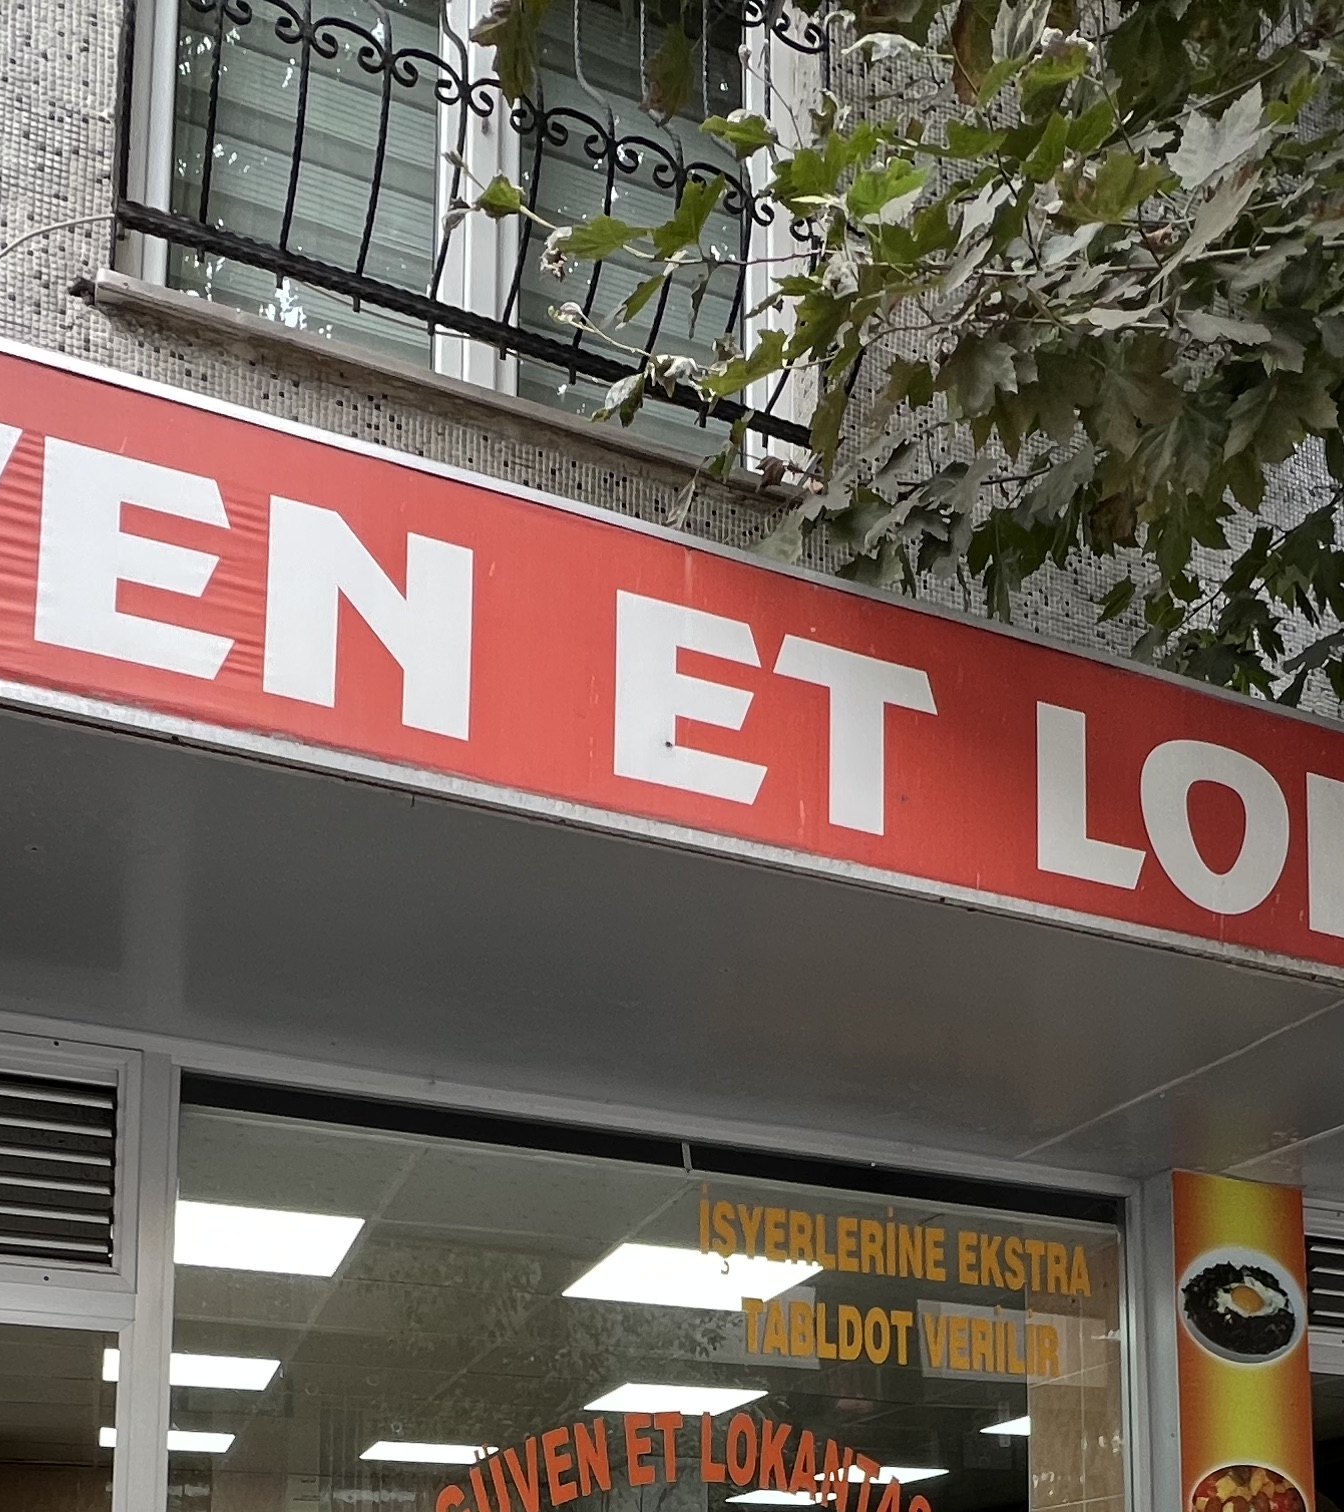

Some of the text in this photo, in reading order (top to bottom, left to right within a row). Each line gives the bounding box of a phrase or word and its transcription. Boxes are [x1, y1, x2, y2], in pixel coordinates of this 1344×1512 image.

[613, 589, 939, 836] ET
[697, 1183, 1092, 1297] İŞYERLERİNE EKSTRA
[742, 1298, 1060, 1377] TABLDOT VERİLİR
[623, 1410, 683, 1487] ET
